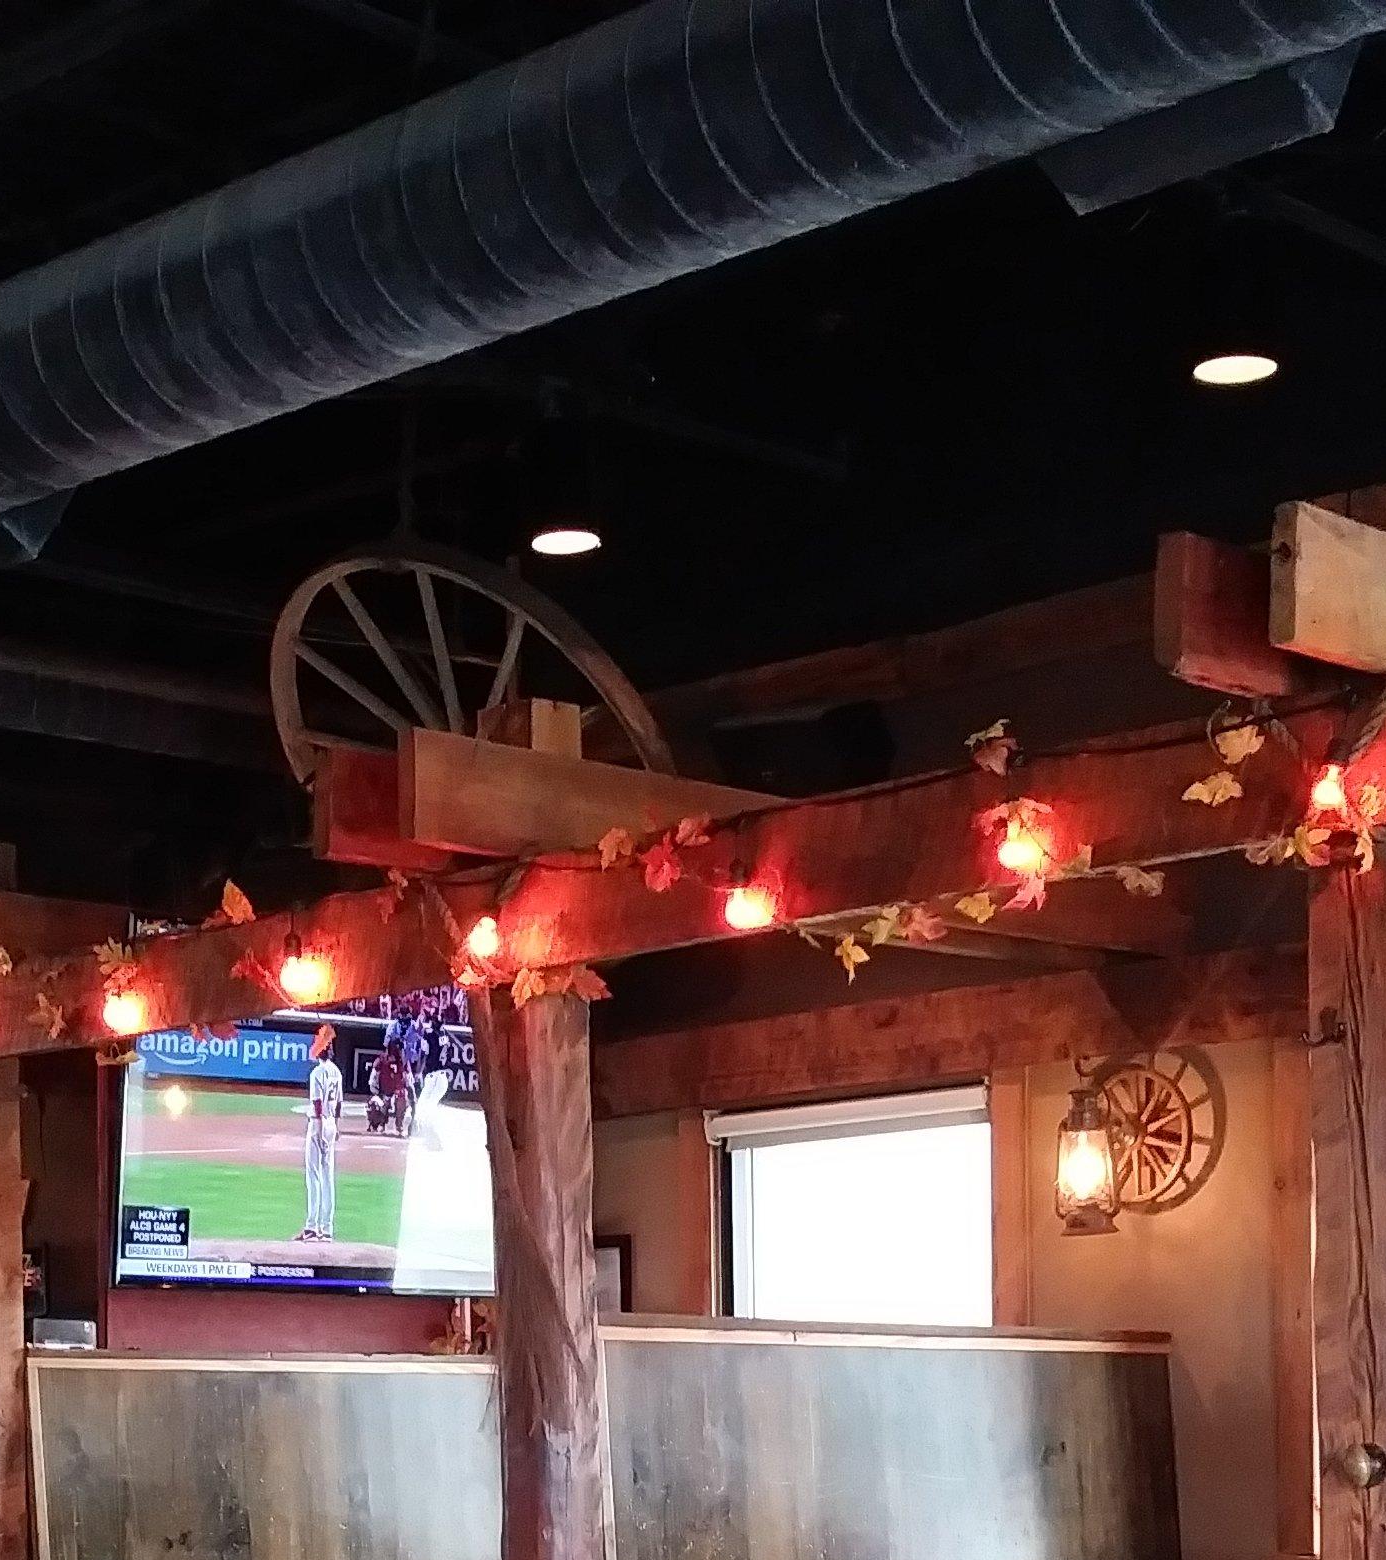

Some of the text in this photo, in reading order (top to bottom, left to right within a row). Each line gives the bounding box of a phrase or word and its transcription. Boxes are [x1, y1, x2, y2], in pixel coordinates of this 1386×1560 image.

[140, 1032, 238, 1059] amazon
[133, 1233, 181, 1244] POSTPONED
[146, 1261, 198, 1274] WEEKDAYS
[209, 1264, 224, 1275] PM
